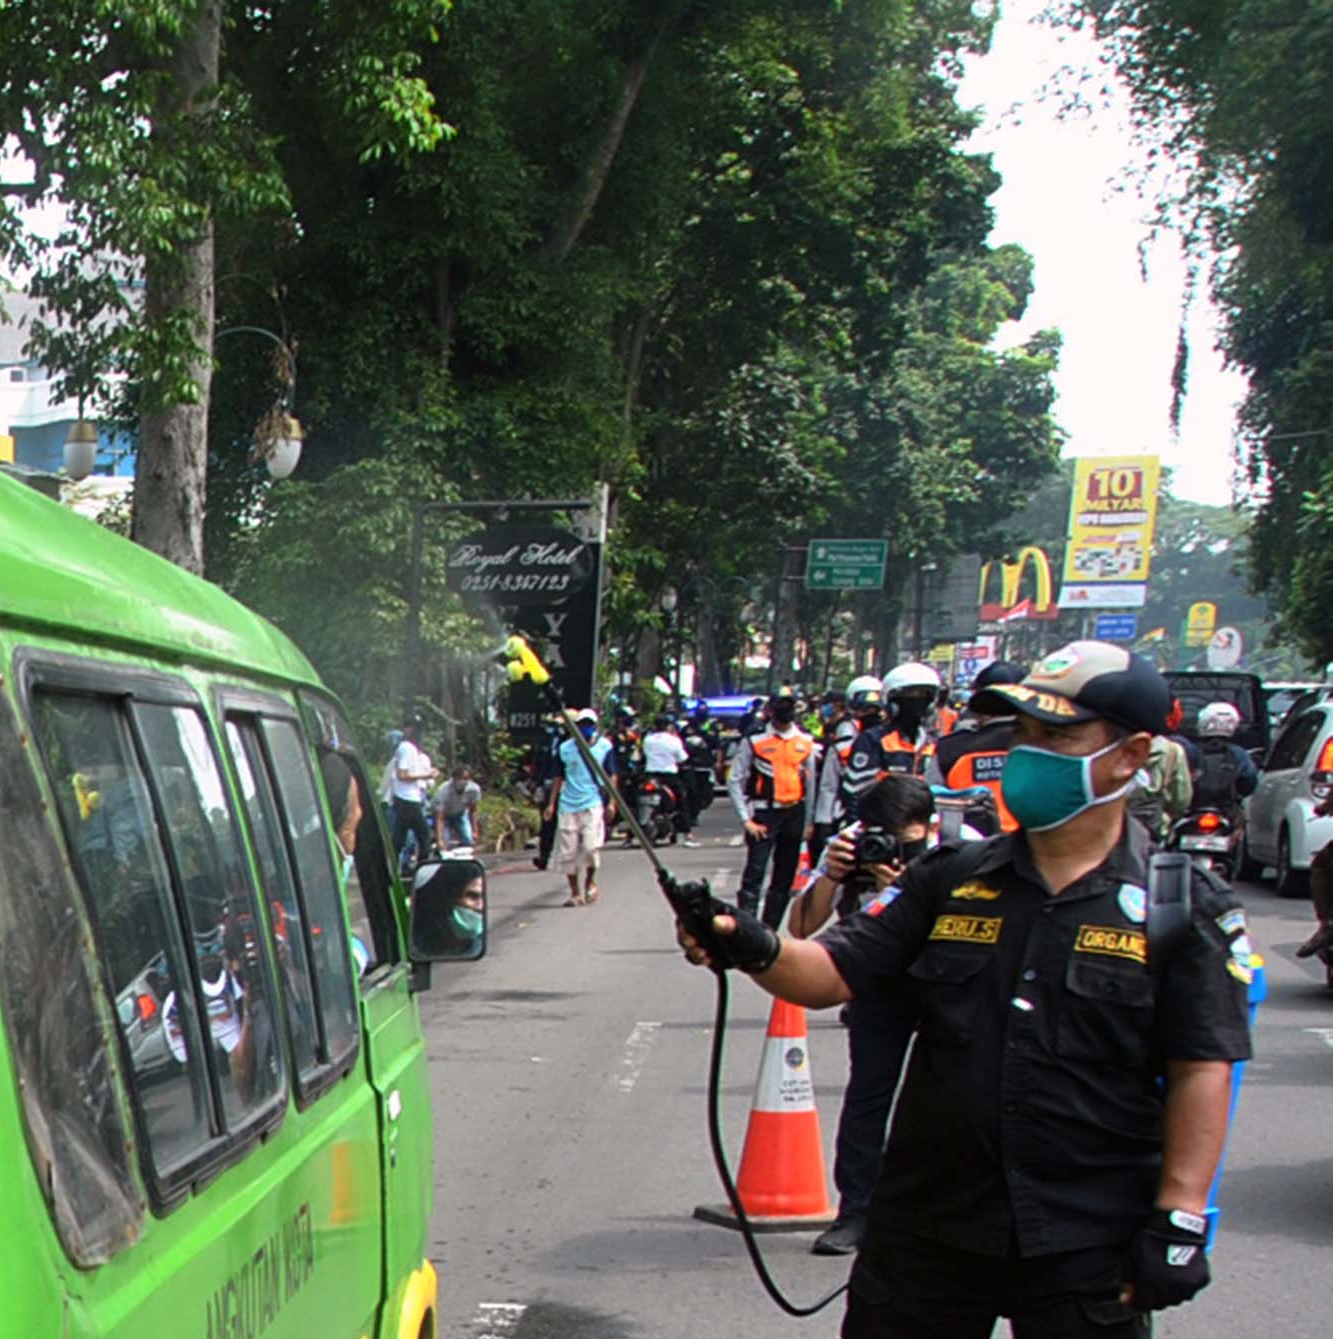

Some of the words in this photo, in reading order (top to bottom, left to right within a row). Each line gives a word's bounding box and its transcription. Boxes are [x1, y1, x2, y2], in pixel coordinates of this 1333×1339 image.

[1094, 470, 1134, 497] 10
[448, 544, 521, 574] Royal
[519, 541, 585, 566] Hotel
